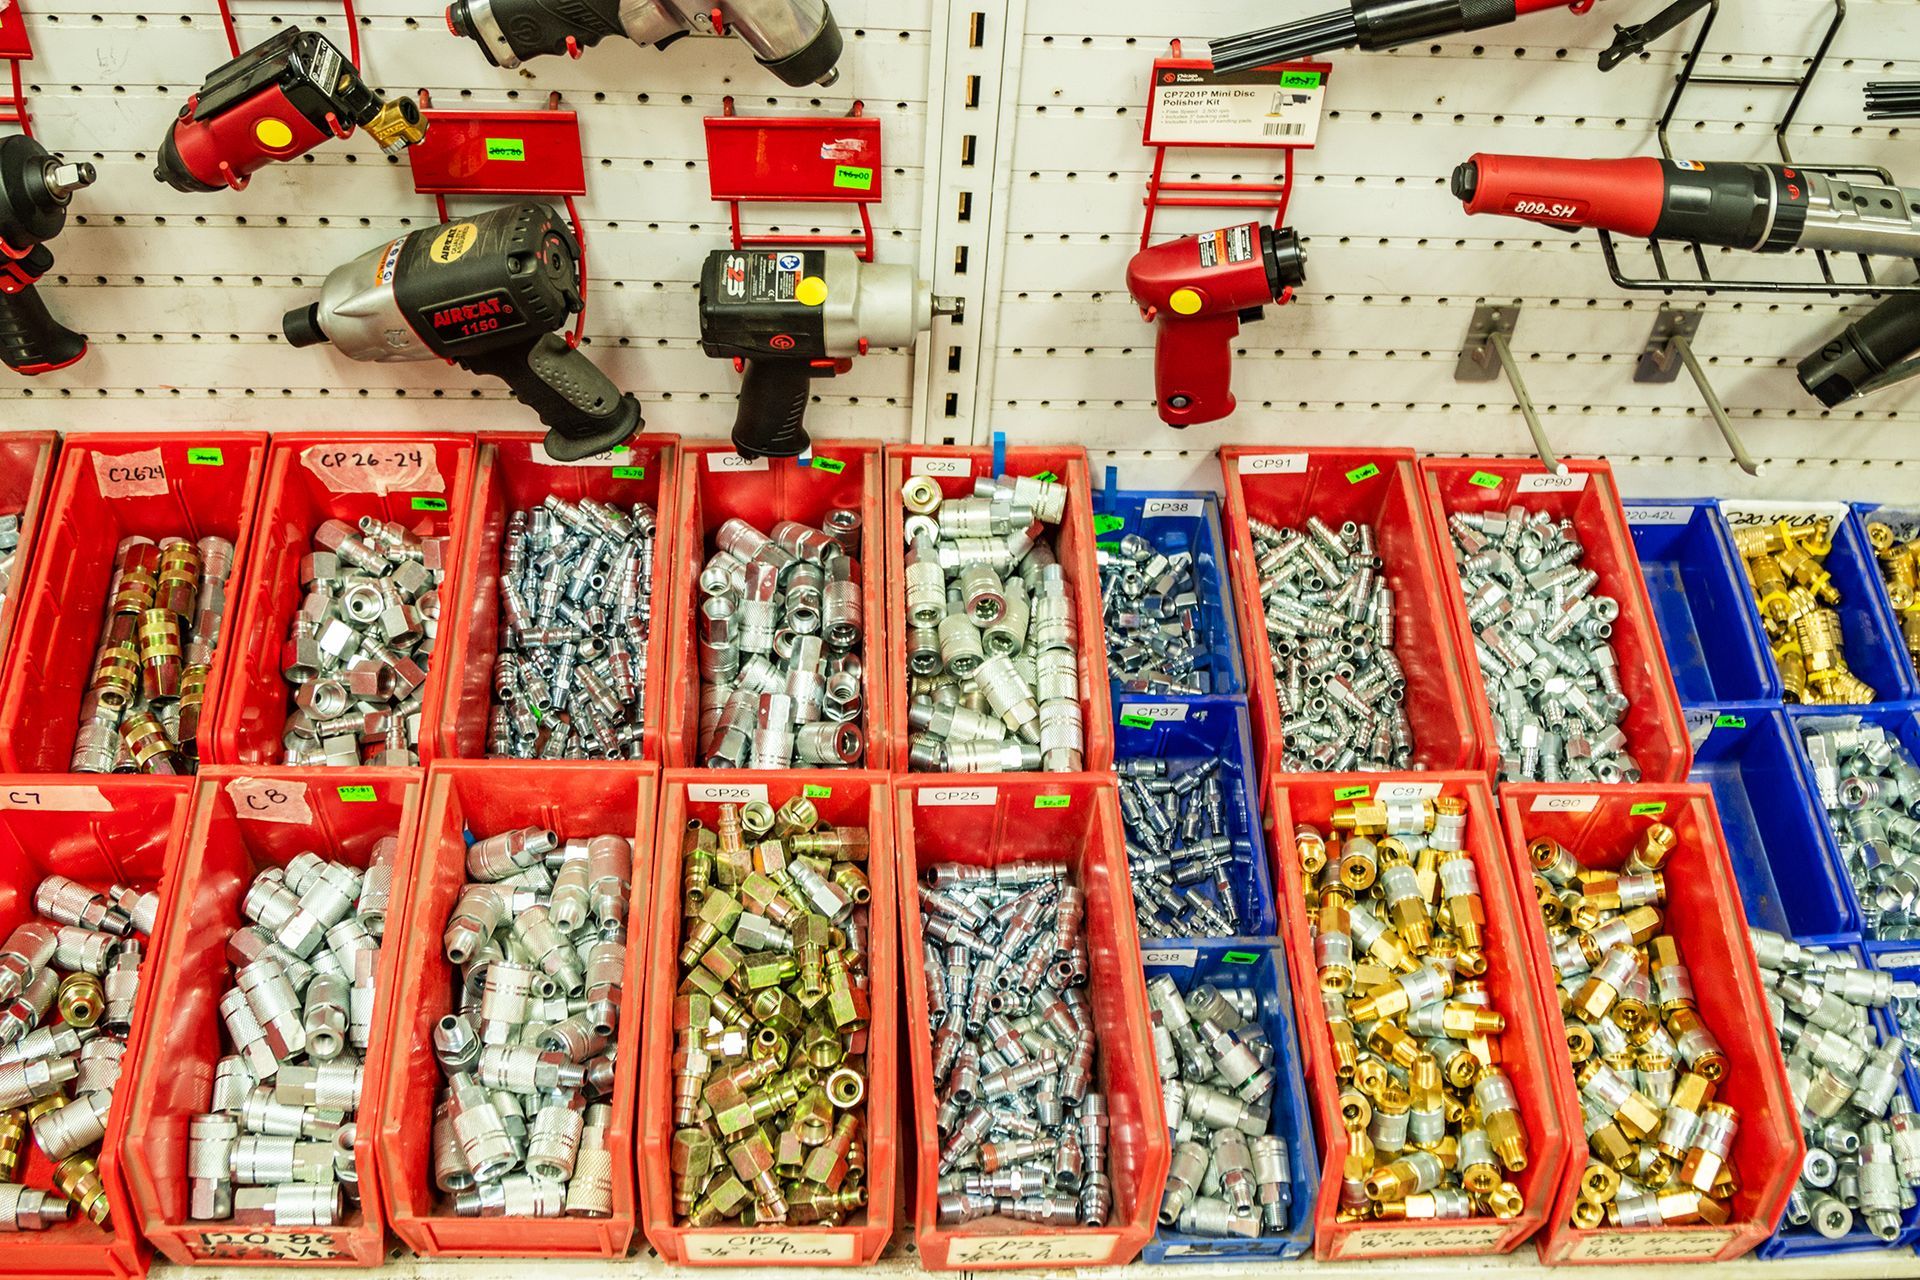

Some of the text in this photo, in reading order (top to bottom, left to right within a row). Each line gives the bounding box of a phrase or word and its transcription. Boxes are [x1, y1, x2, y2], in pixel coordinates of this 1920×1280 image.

[1515, 200, 1577, 218] 809-SH
[434, 297, 502, 329] AIRCAT
[461, 318, 498, 336] 1150
[926, 461, 956, 472] C25
[1252, 459, 1292, 469] CP91
[109, 465, 165, 482] C2624
[1533, 477, 1573, 488] CP90
[1150, 502, 1189, 513] CP38
[1137, 707, 1179, 717] CP37
[705, 788, 751, 798] CP26
[934, 791, 980, 801] CP25
[1392, 787, 1423, 797] C91
[9, 791, 40, 805] C7
[1548, 799, 1582, 808] C90
[1146, 953, 1180, 962] C38
